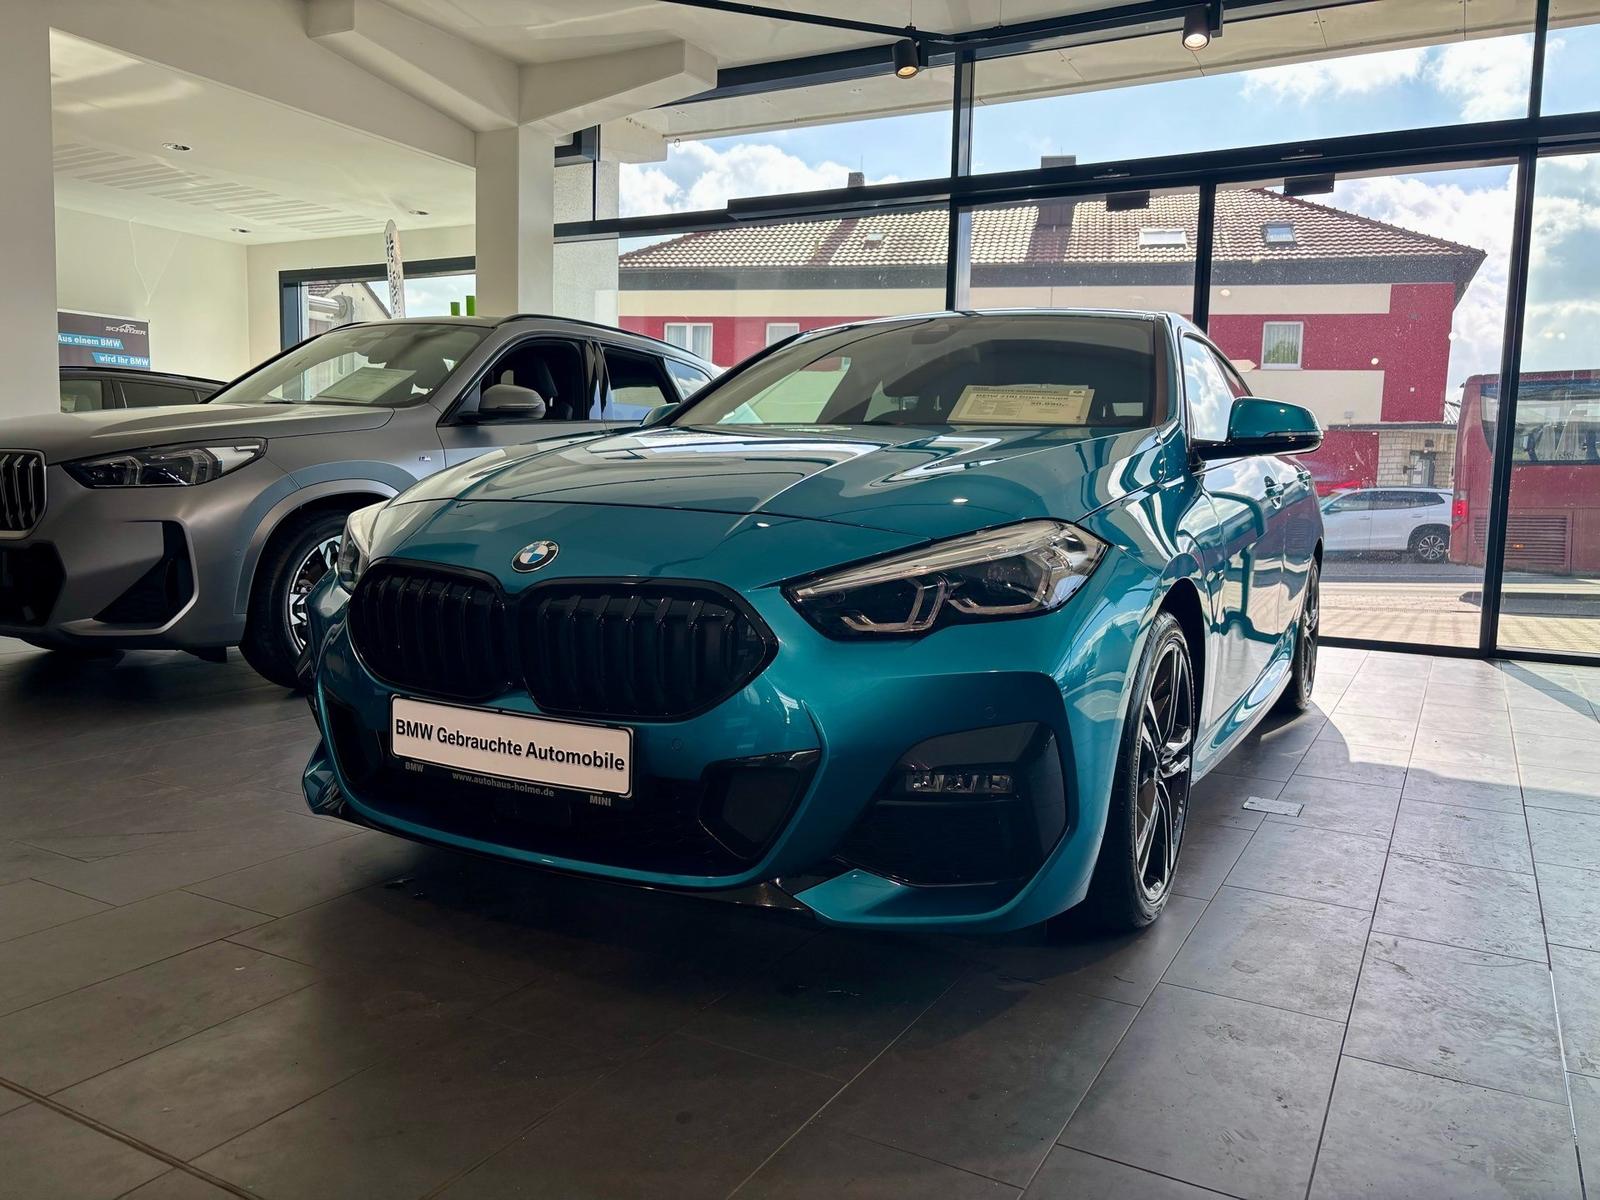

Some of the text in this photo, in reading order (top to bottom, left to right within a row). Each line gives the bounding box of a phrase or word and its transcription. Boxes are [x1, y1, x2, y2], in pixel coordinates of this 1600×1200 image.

[57, 334, 121, 348] Aus einem BMW
[99, 354, 116, 363] wird
[129, 357, 149, 366] BMW
[395, 718, 625, 771] BMW Gebrauchte Automobile
[405, 761, 424, 773] BMW
[452, 772, 555, 797] www.autohaus-holme.de
[589, 794, 612, 807] MINI
